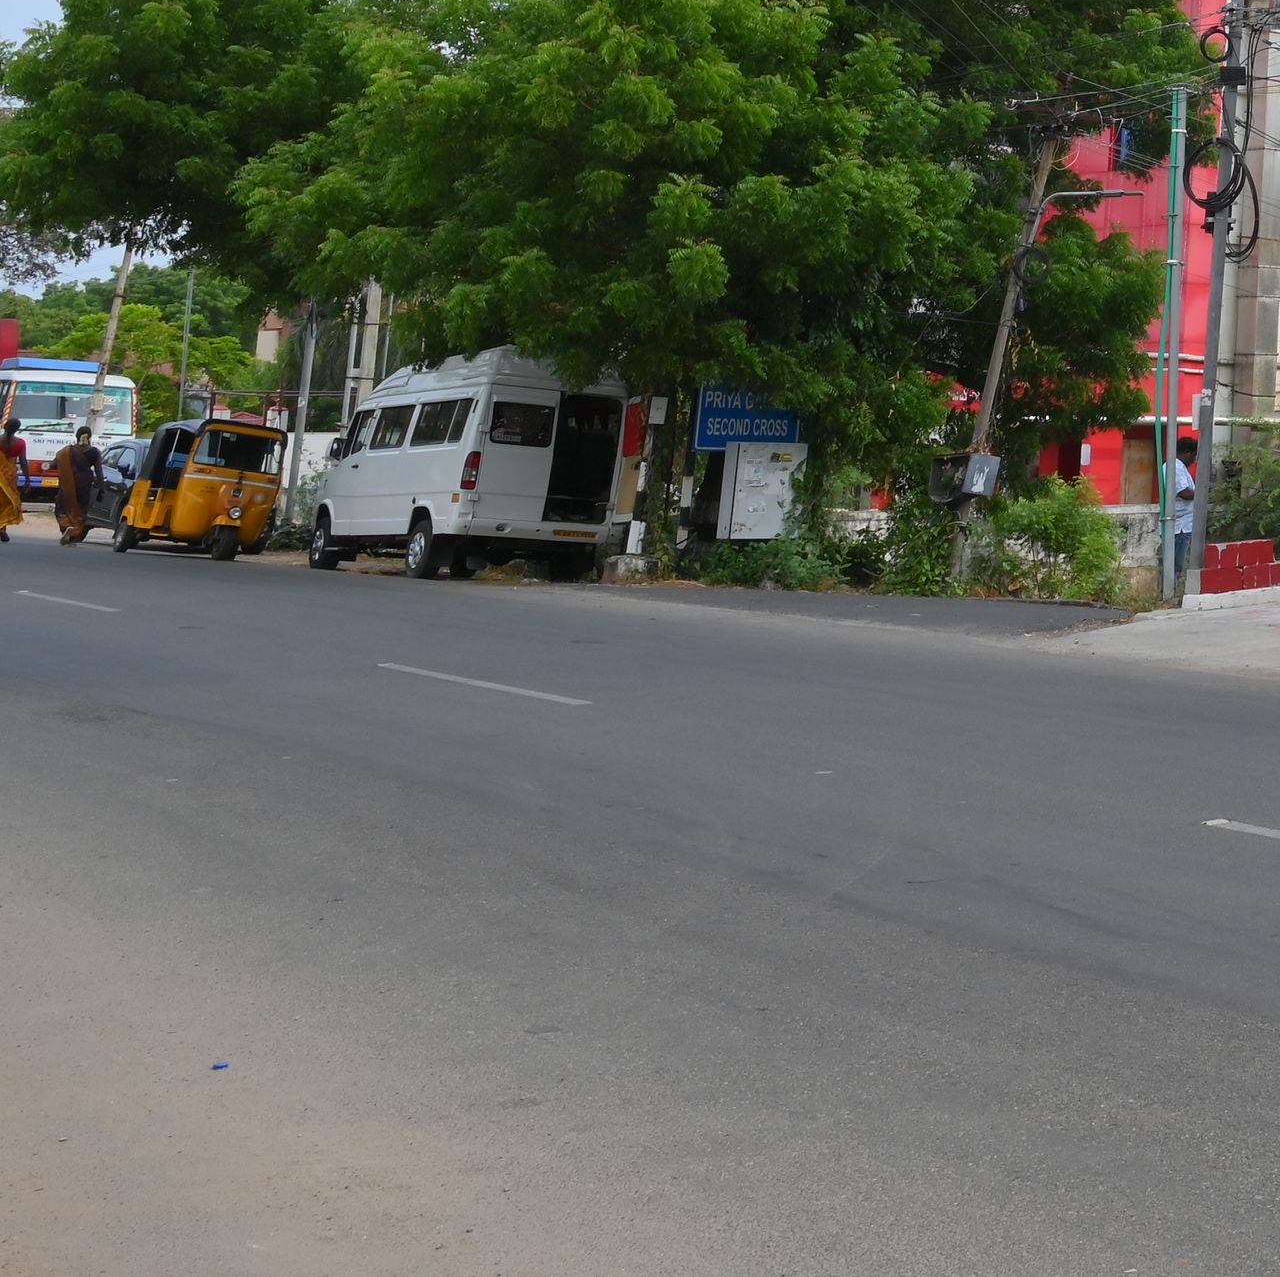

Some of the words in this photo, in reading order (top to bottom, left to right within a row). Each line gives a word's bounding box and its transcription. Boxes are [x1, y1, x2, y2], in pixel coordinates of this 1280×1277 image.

[704, 390, 741, 409] PRIYA
[706, 417, 751, 436] SECOND
[752, 419, 788, 437] CROSS
